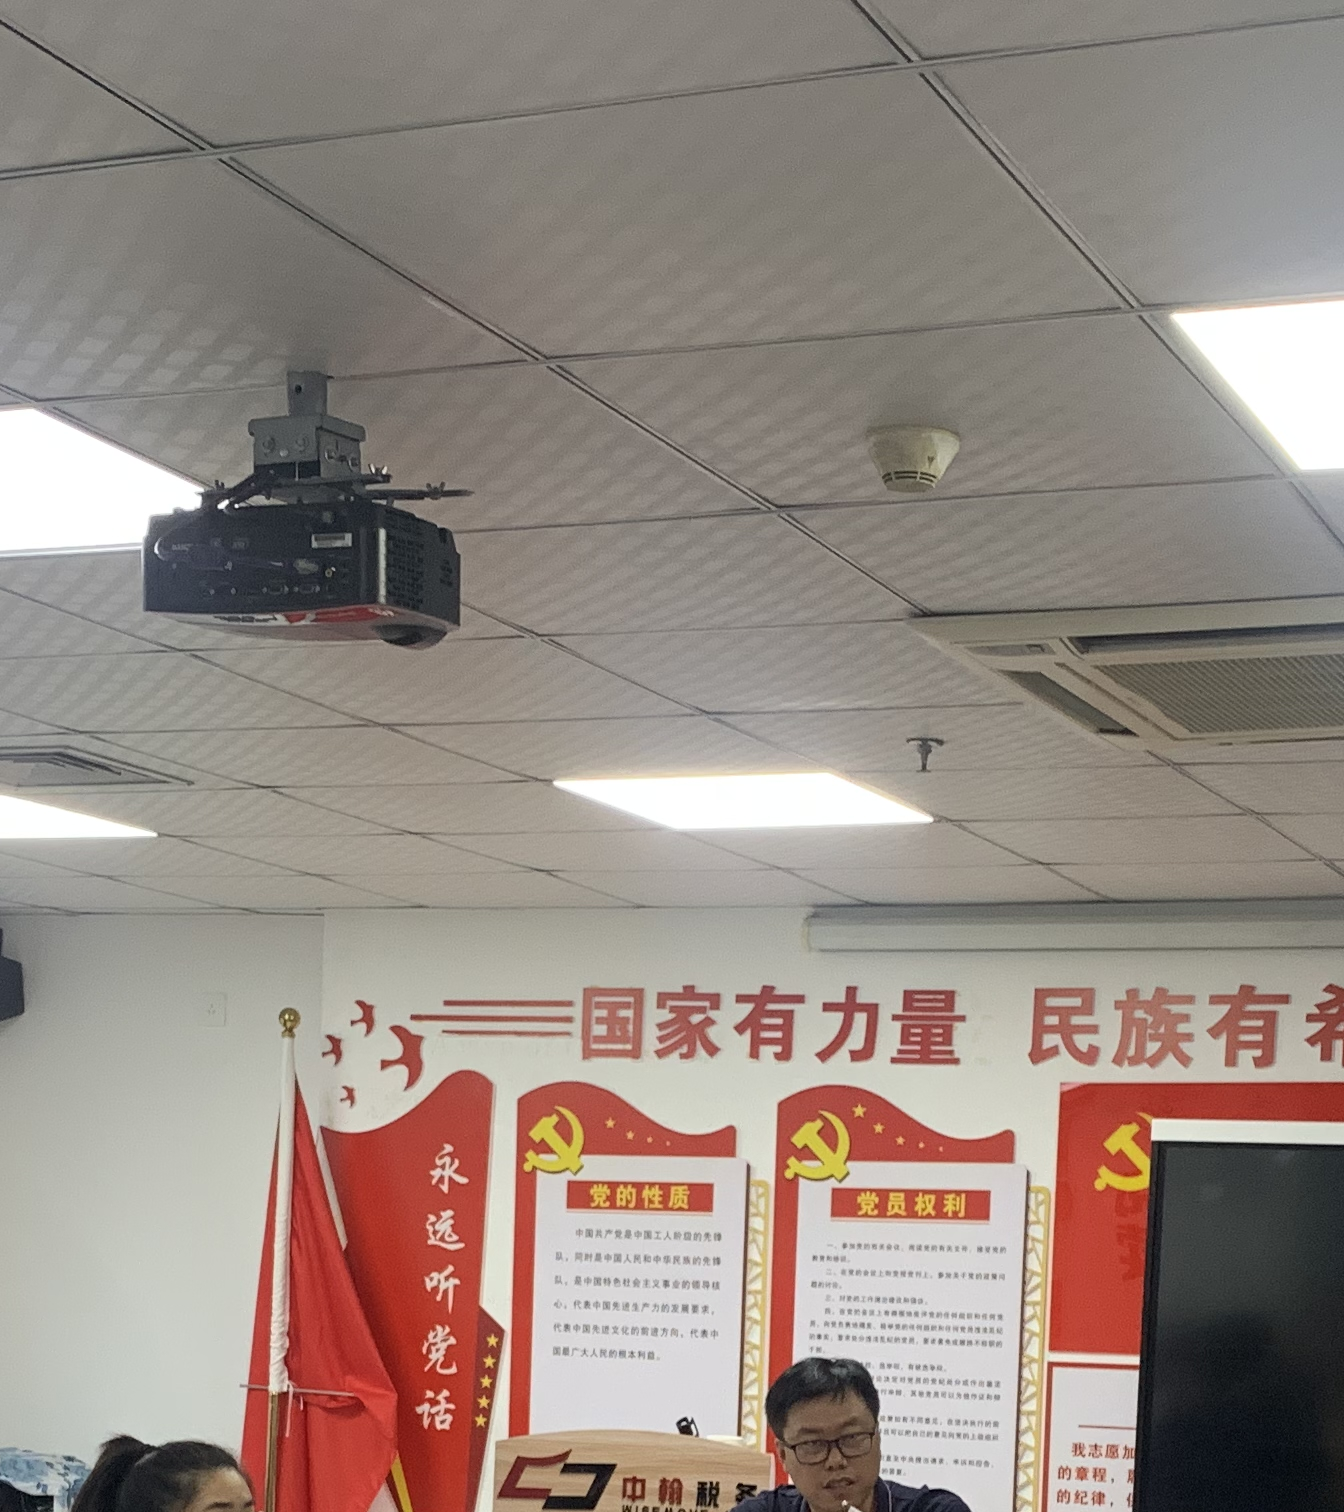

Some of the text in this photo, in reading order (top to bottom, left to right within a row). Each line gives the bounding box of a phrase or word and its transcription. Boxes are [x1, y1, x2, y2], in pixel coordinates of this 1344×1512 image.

[582, 985, 966, 1066] 国家有力量
[589, 1183, 691, 1210] 党的性质
[856, 1191, 967, 1217] 党员权利
[415, 1143, 469, 1431] 永远听党话
